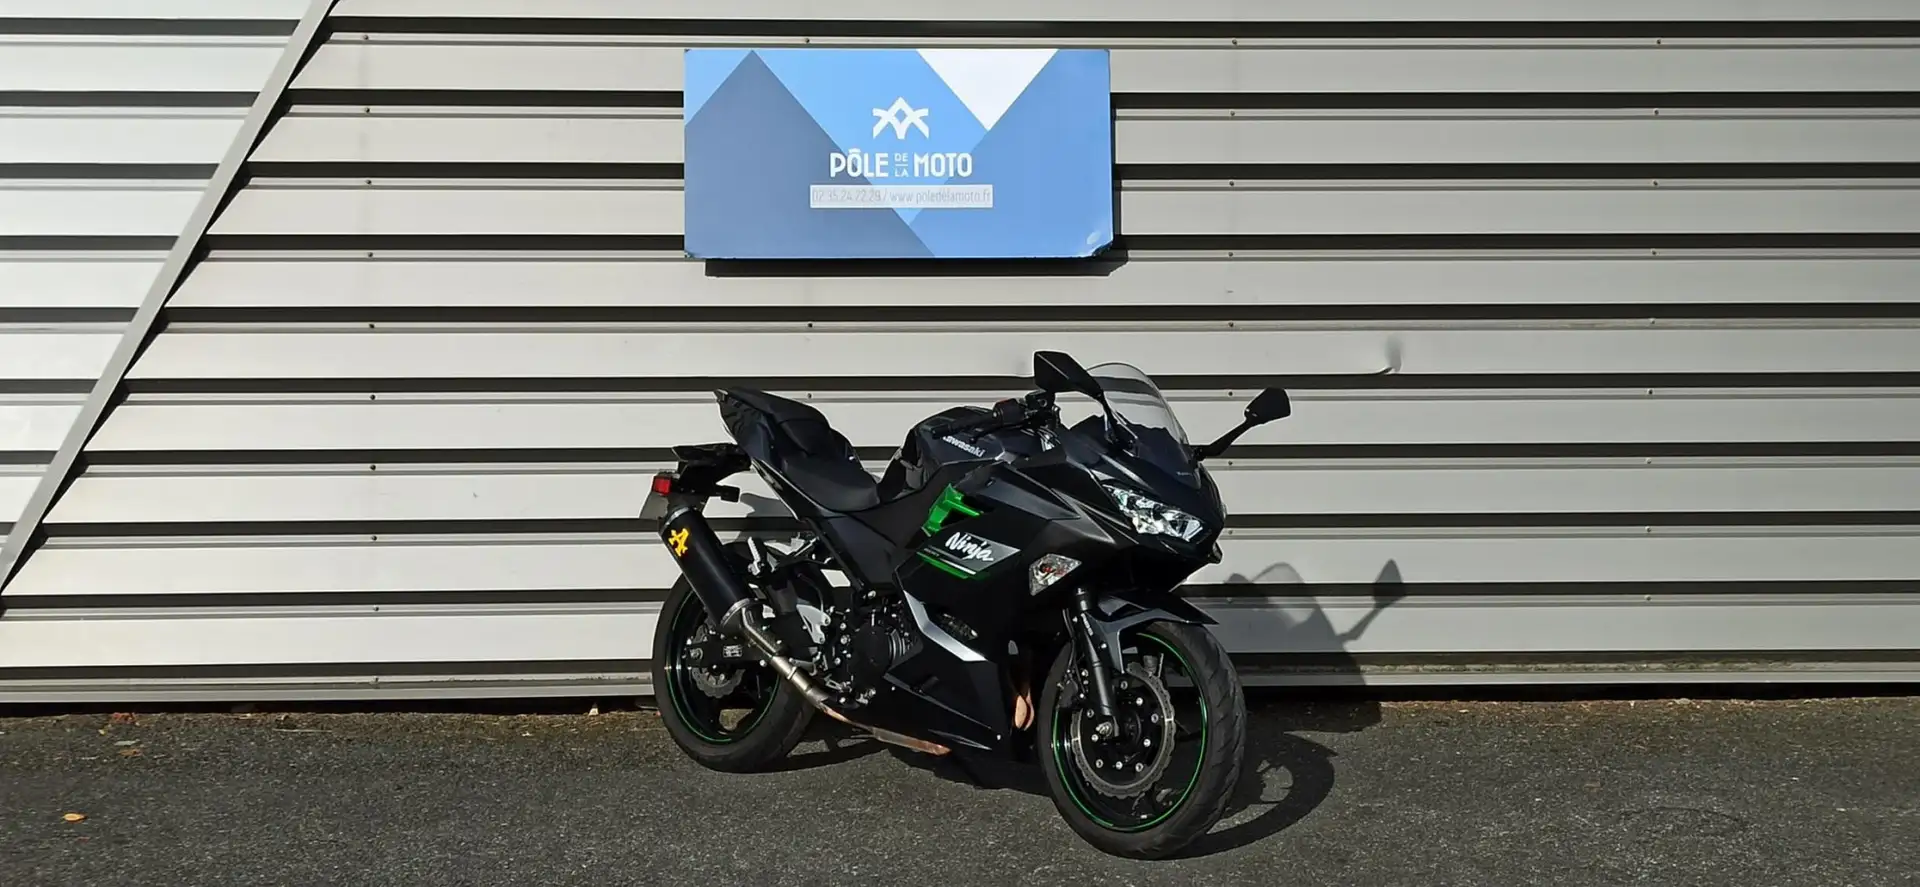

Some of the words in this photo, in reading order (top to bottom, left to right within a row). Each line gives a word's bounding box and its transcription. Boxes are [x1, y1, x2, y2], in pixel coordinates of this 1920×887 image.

[830, 148, 888, 177] PÔLE
[894, 152, 909, 162] DE
[914, 153, 973, 177] MOTO
[894, 168, 909, 177] LA
[945, 531, 994, 561] Ninja
